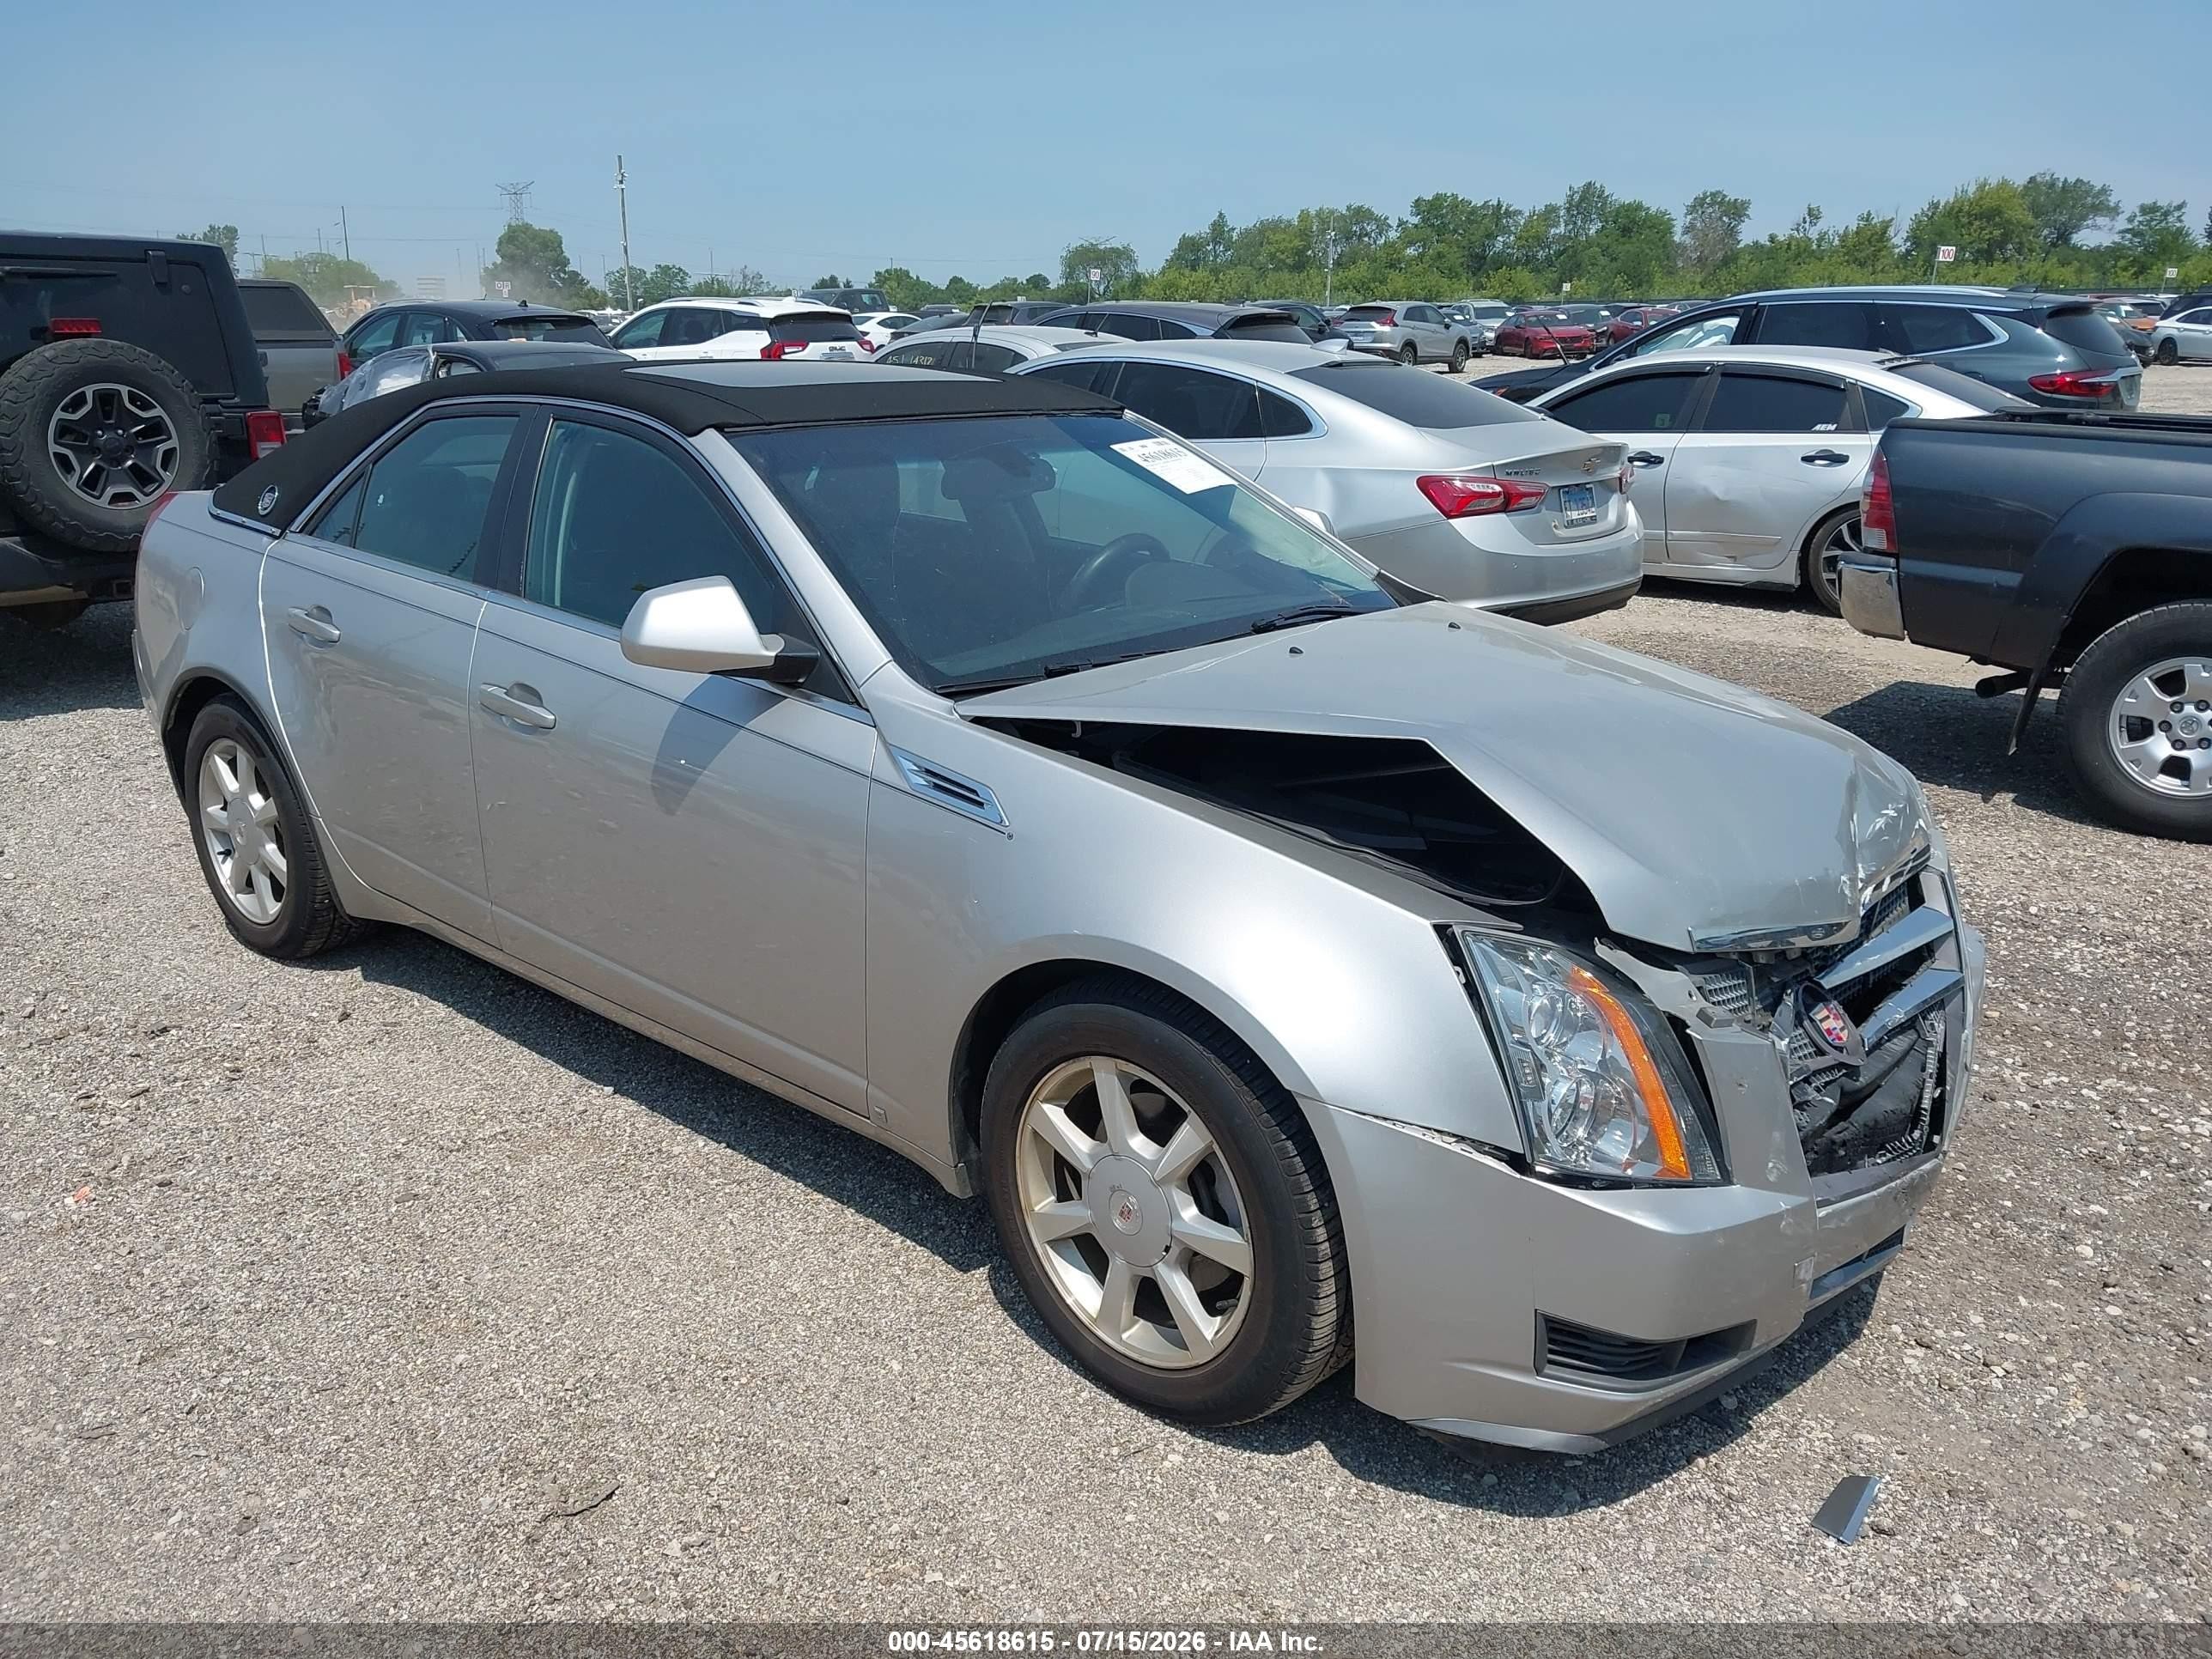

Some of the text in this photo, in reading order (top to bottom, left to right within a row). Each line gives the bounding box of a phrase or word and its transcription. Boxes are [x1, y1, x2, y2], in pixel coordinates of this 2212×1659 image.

[1942, 248, 1954, 259] 100
[1092, 270, 1100, 279] 90
[1504, 467, 1541, 477] MALIBU
